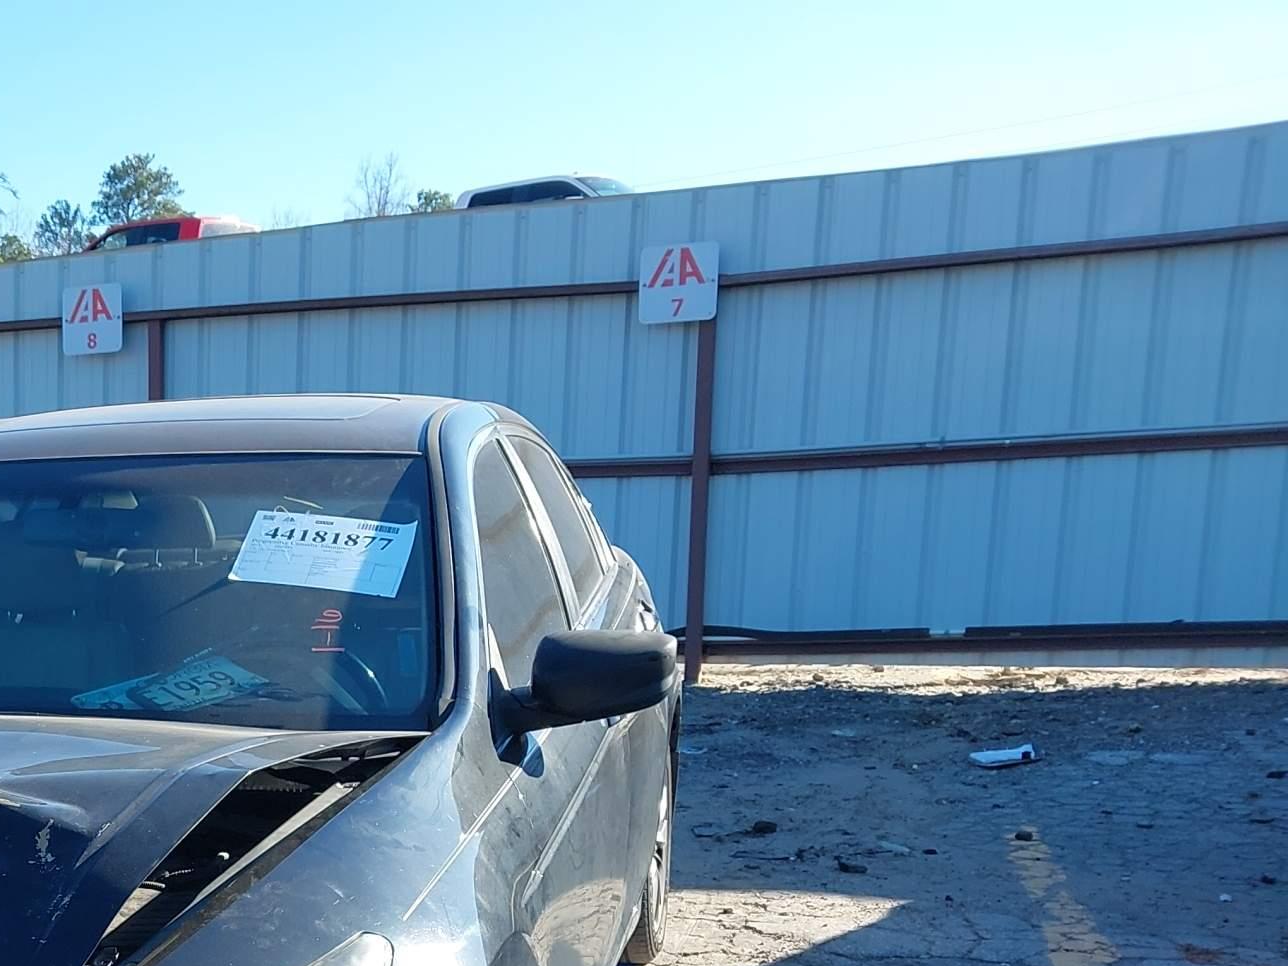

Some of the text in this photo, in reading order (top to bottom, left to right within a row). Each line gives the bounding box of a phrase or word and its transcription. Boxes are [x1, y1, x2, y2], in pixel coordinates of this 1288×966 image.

[671, 298, 685, 317] 7
[87, 333, 97, 349] 8
[263, 526, 394, 551] 44181877
